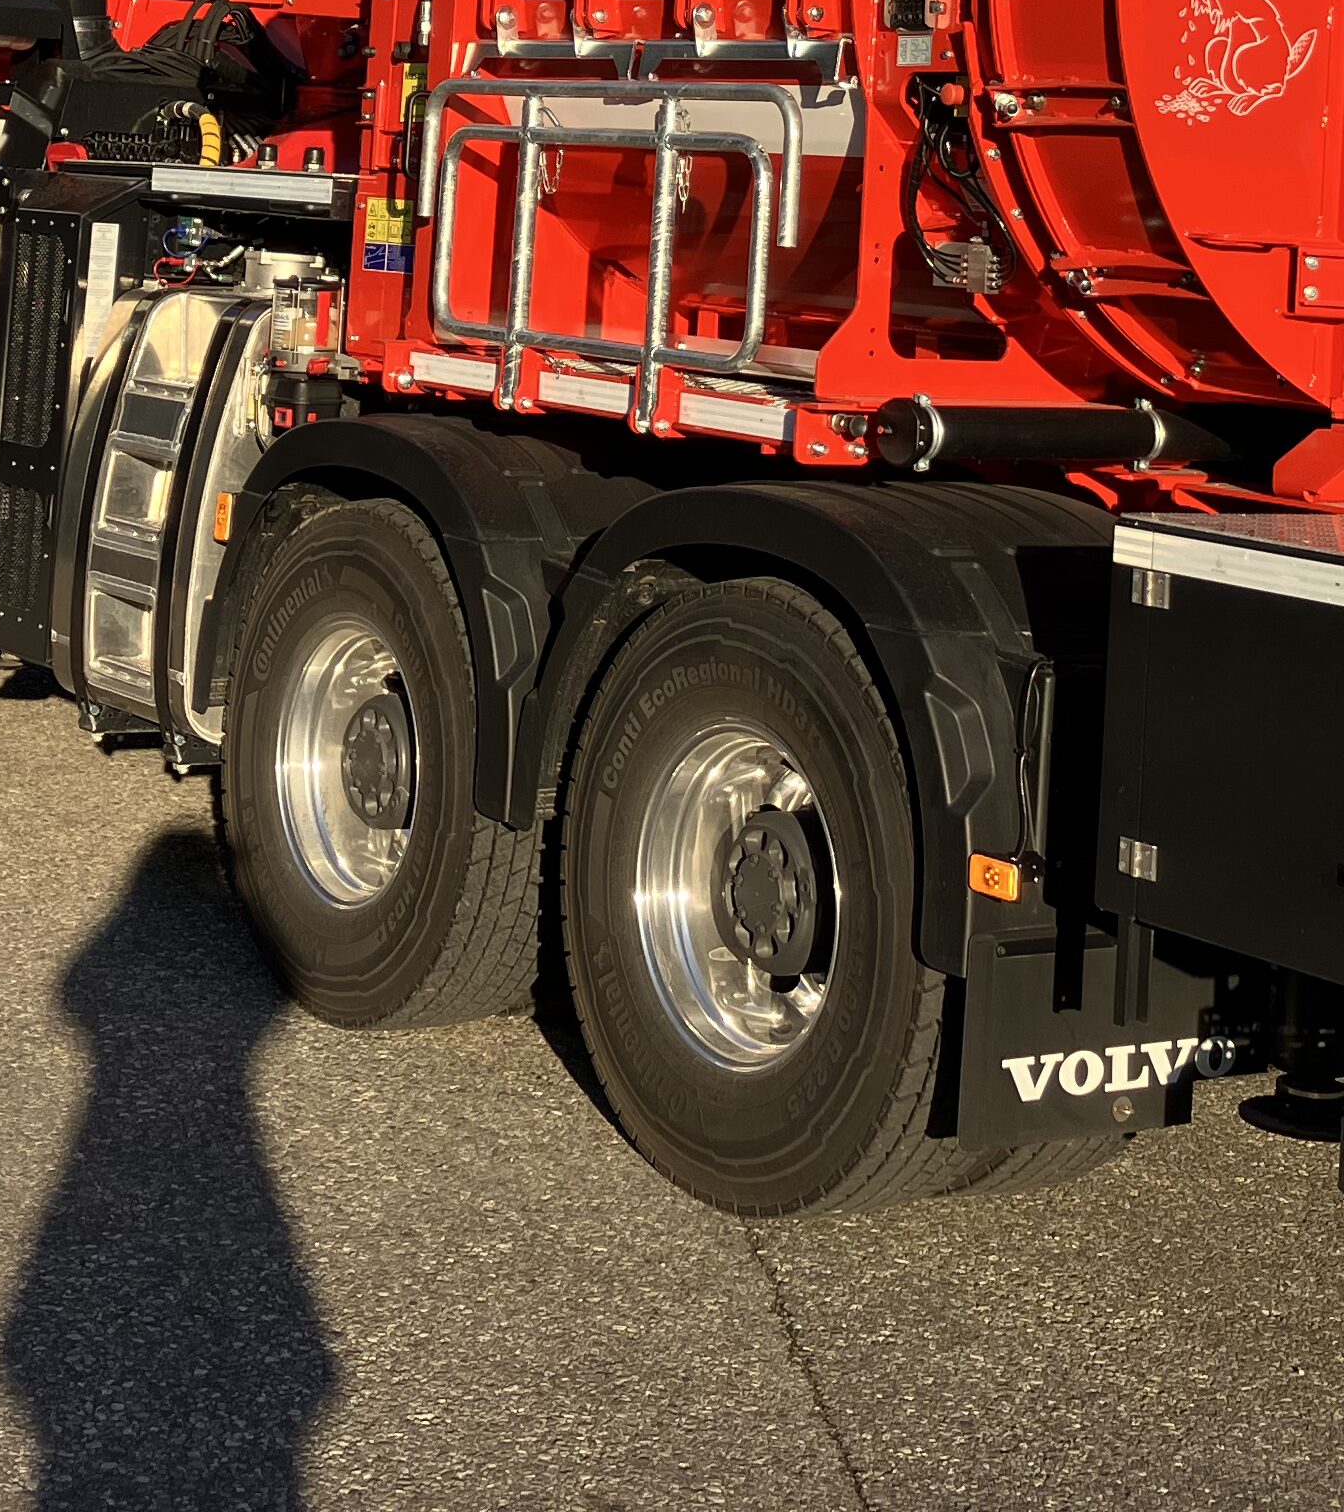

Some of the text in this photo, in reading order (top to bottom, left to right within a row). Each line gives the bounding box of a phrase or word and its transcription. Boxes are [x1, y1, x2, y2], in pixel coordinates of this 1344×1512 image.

[252, 566, 323, 682] Continental
[602, 712, 642, 790] Conti
[637, 656, 762, 721] EcoRegional
[1001, 1036, 1237, 1103] VOLVO
